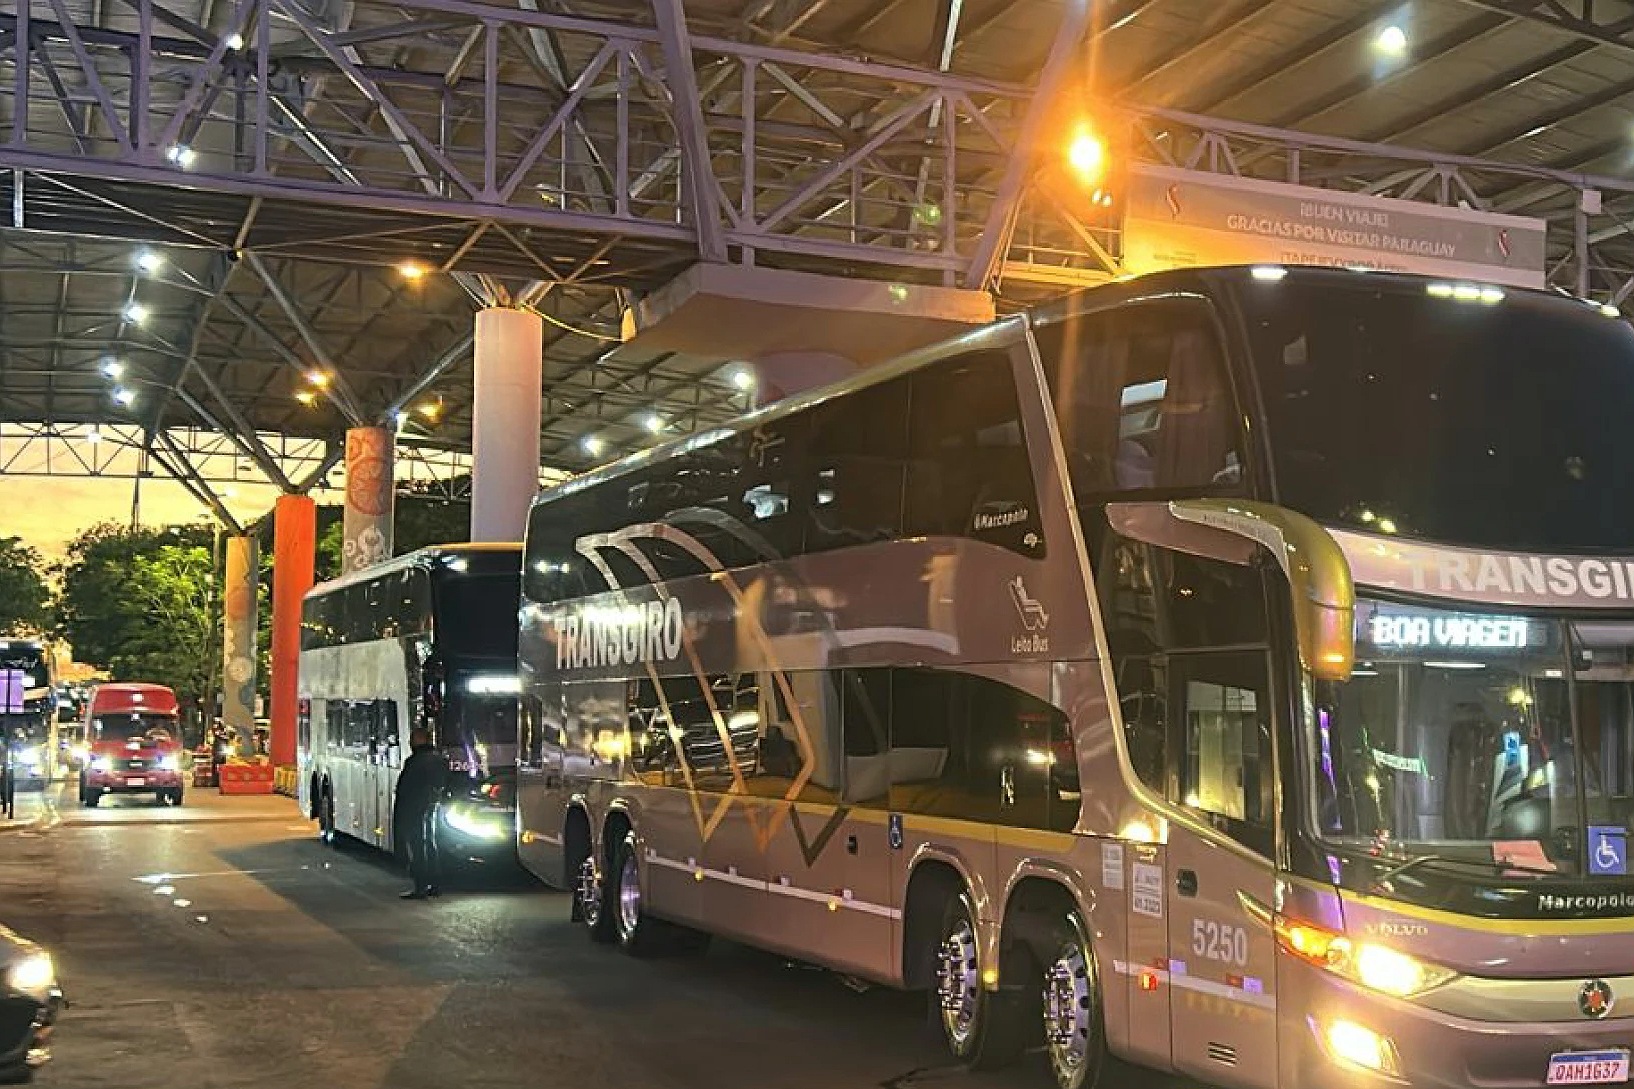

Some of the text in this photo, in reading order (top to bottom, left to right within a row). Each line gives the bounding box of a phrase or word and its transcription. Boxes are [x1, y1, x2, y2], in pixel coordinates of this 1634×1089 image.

[1227, 214, 1455, 257] GRACIAS POR VISITAR PARAGUAY
[554, 598, 682, 669] TRANSGIRO
[1373, 615, 1430, 645] BOA
[1538, 892, 1634, 911] Marcopolo
[1192, 918, 1247, 967] 5250
